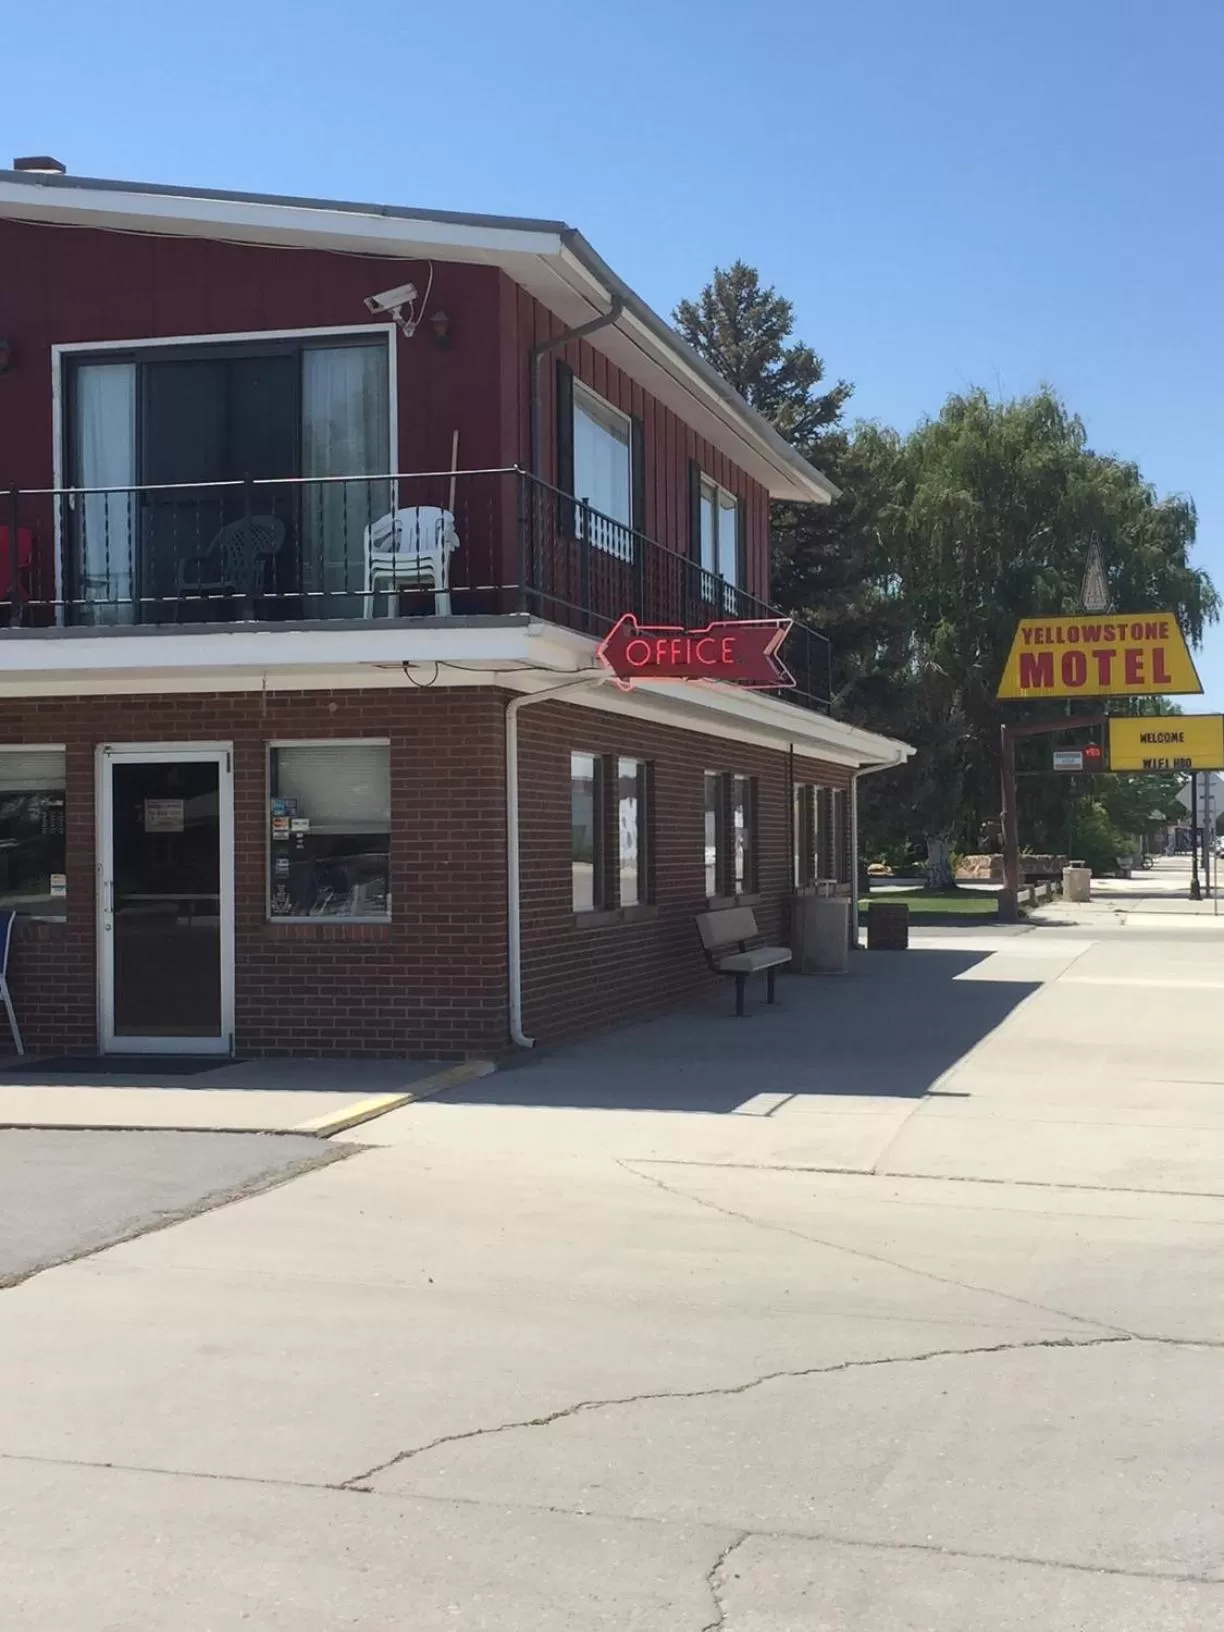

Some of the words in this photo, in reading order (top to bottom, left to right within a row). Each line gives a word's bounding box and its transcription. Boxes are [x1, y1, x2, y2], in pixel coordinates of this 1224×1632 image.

[1021, 622, 1169, 645] YELLOWSTONE
[626, 638, 735, 665] OFFICE
[1019, 648, 1172, 689] MOTEL
[1139, 732, 1185, 744] WELCOME
[1142, 758, 1169, 769] WIFI
